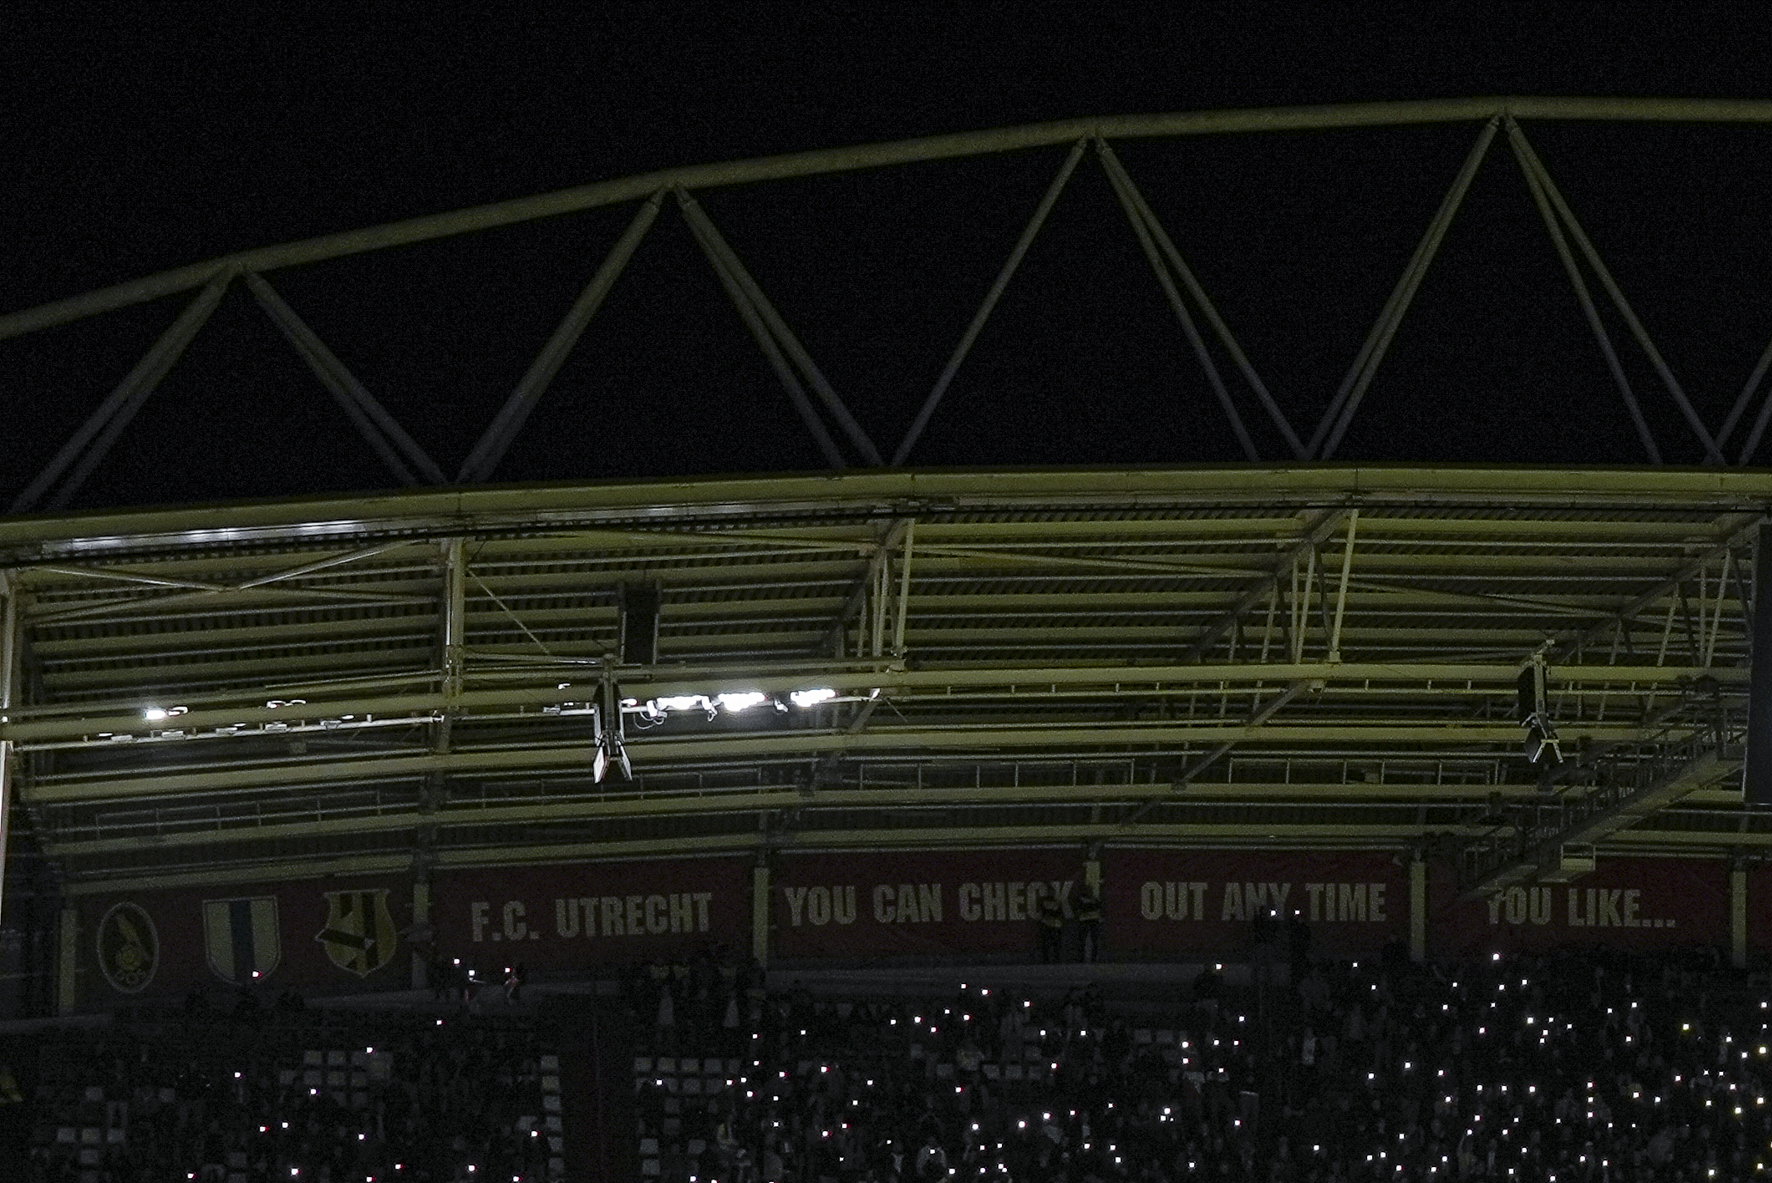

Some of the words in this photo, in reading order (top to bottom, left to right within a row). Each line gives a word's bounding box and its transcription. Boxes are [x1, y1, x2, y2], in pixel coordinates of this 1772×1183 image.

[471, 902, 540, 942] F.C.
[556, 892, 713, 938] UTRECHT
[784, 886, 857, 926] YOU
[874, 883, 944, 925] CAN
[959, 880, 1076, 921] CHECK
[1141, 882, 1208, 922] OUT
[1221, 881, 1291, 922] ANY
[1305, 882, 1387, 923] TIME
[1487, 887, 1552, 925] YOU
[1568, 888, 1677, 929] LIKE...
